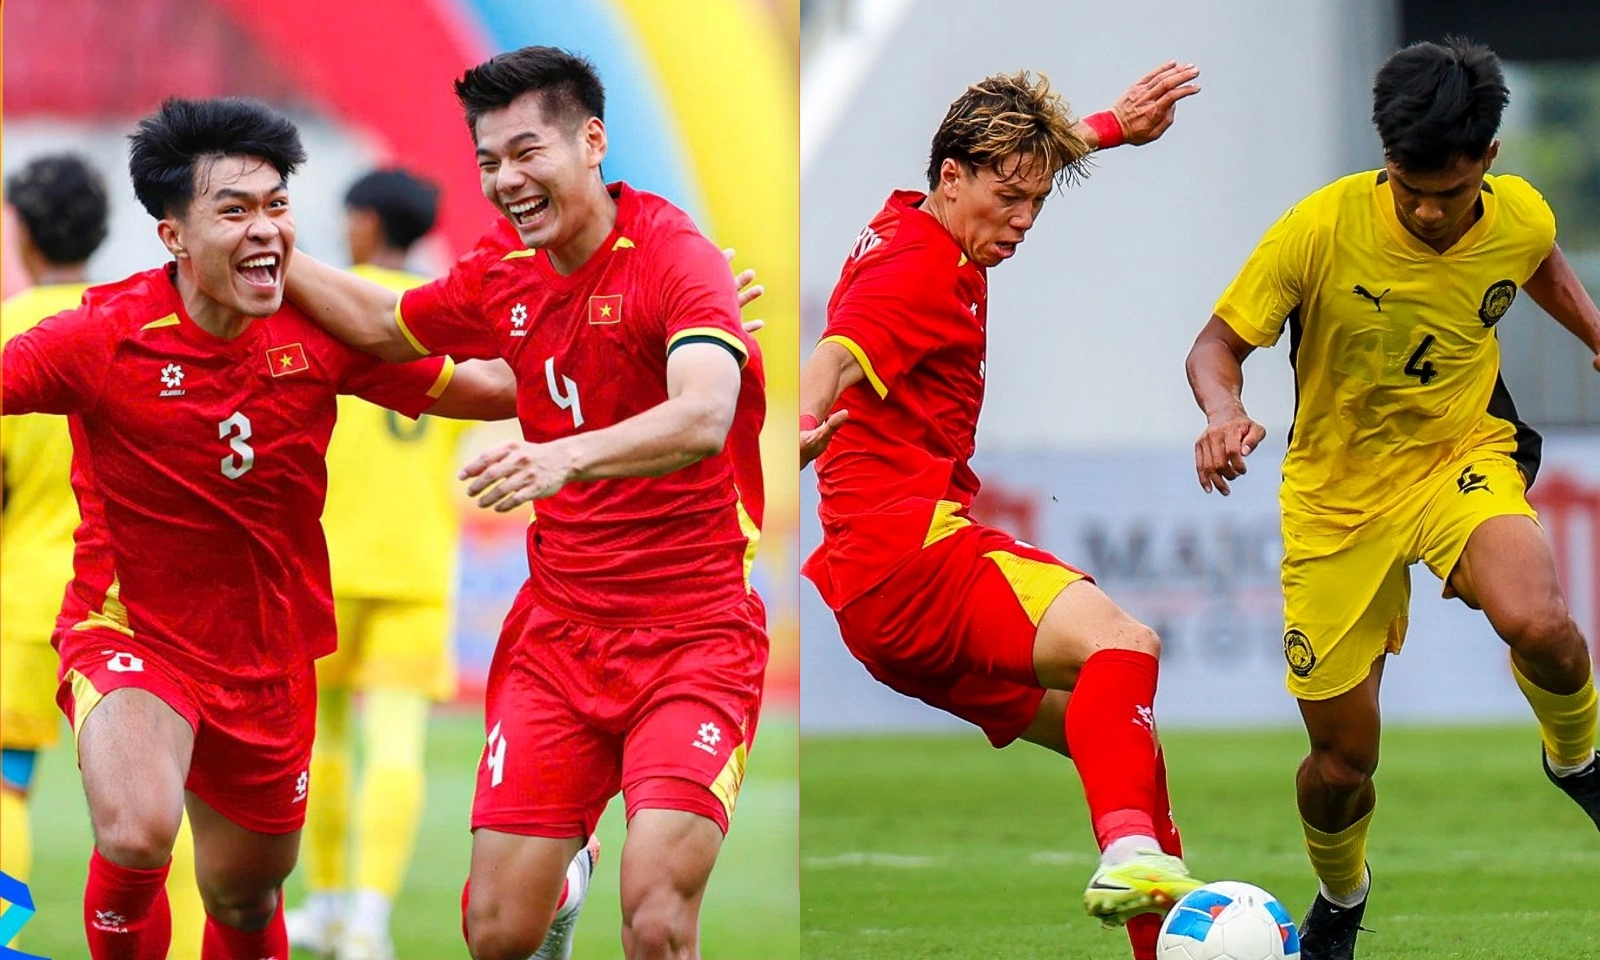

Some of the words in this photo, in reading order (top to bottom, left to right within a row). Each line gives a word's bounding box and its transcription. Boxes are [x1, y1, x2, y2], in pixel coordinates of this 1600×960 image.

[544, 356, 584, 428] 4
[1403, 334, 1438, 385] 4
[218, 411, 254, 480] 3
[487, 719, 507, 788] 4
